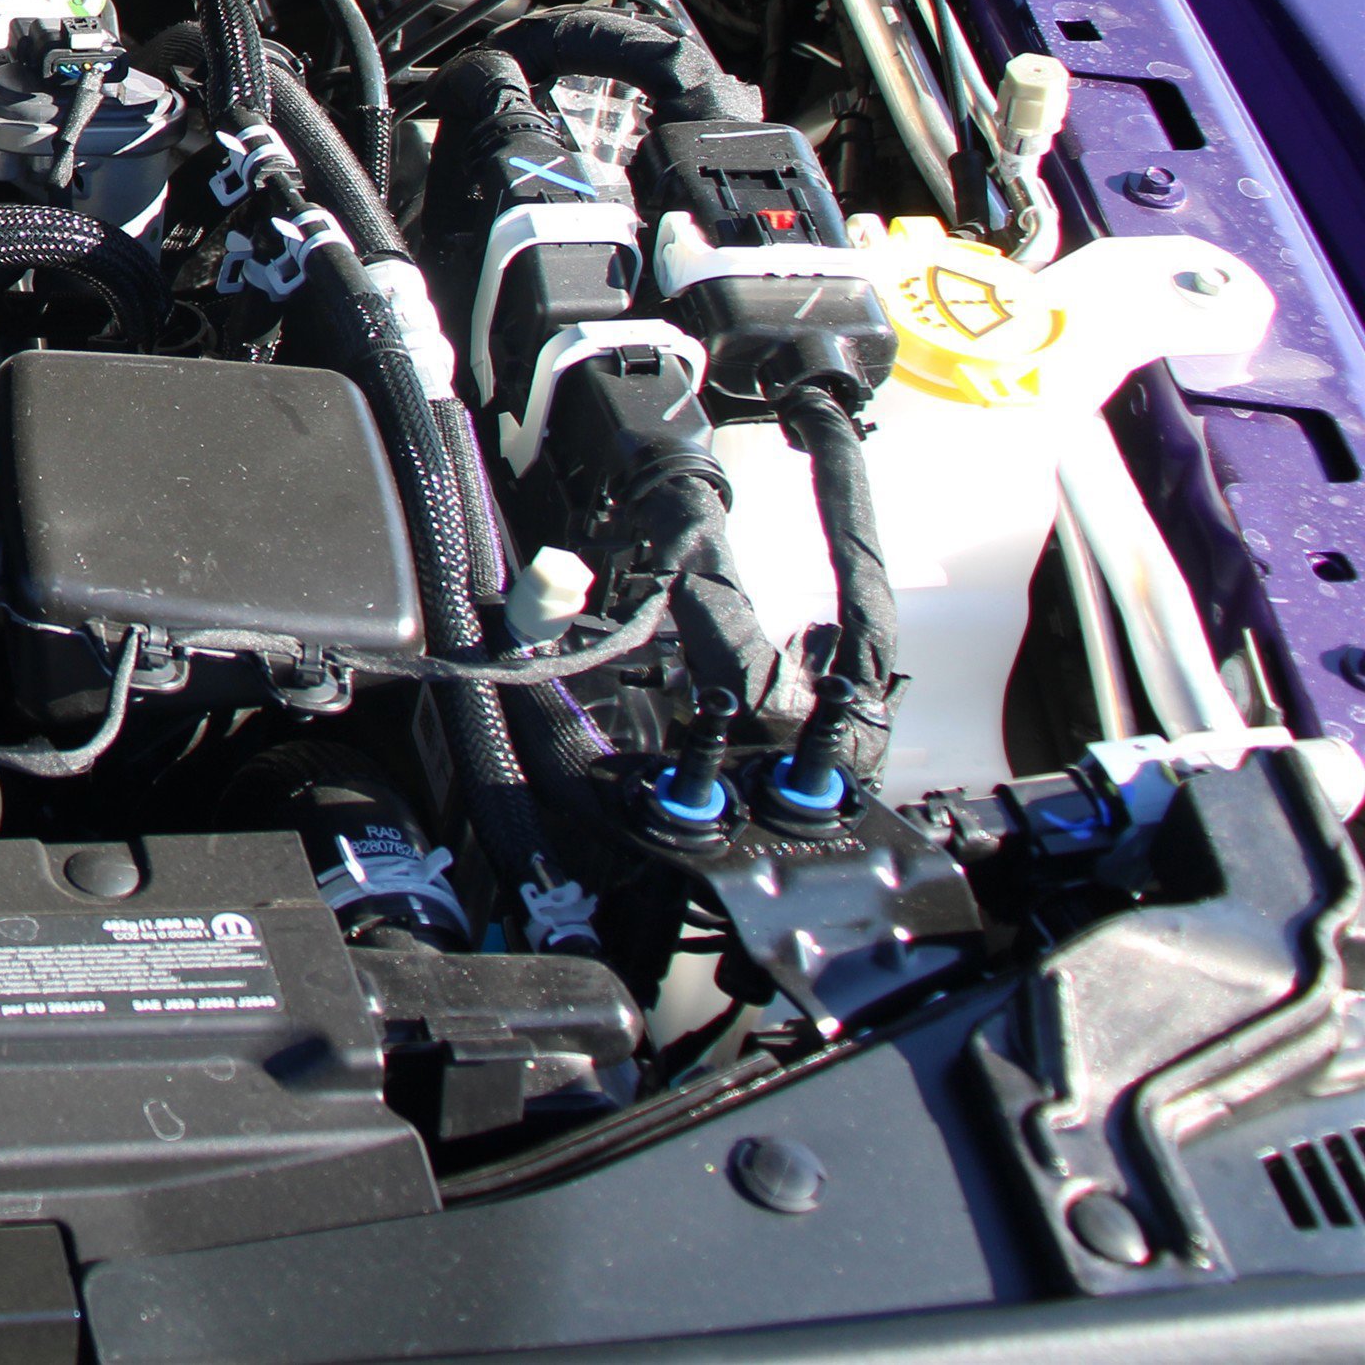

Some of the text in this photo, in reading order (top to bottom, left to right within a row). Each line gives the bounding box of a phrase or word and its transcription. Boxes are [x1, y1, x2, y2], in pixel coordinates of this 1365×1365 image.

[365, 824, 402, 840] RAD
[112, 931, 140, 941] CO2
[1, 1004, 24, 1017] per
[25, 1002, 46, 1014] EU
[132, 999, 162, 1011] SAE
